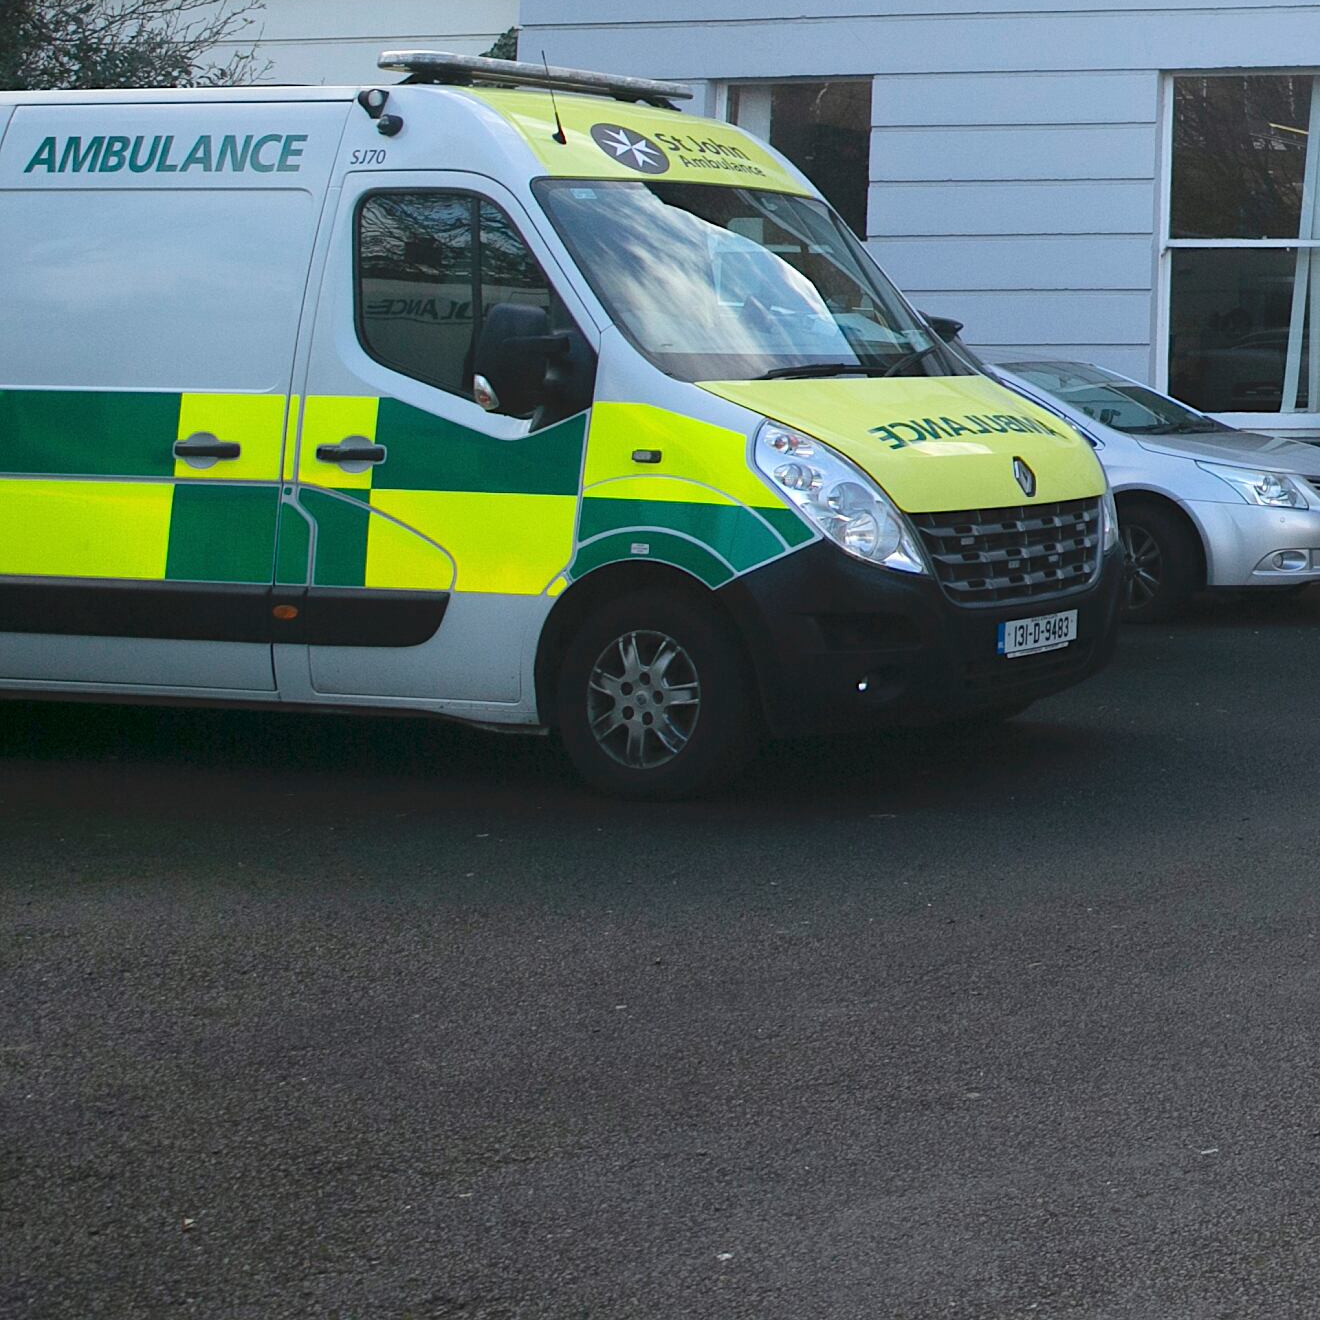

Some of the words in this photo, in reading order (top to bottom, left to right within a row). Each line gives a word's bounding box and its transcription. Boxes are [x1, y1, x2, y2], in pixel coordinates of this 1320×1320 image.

[24, 134, 309, 173] AMBULANCE
[350, 149, 386, 165] SJ70
[655, 133, 693, 152] St
[686, 135, 751, 161] John
[679, 154, 766, 177] Ambulance
[1014, 616, 1069, 647] 131-D-9483
